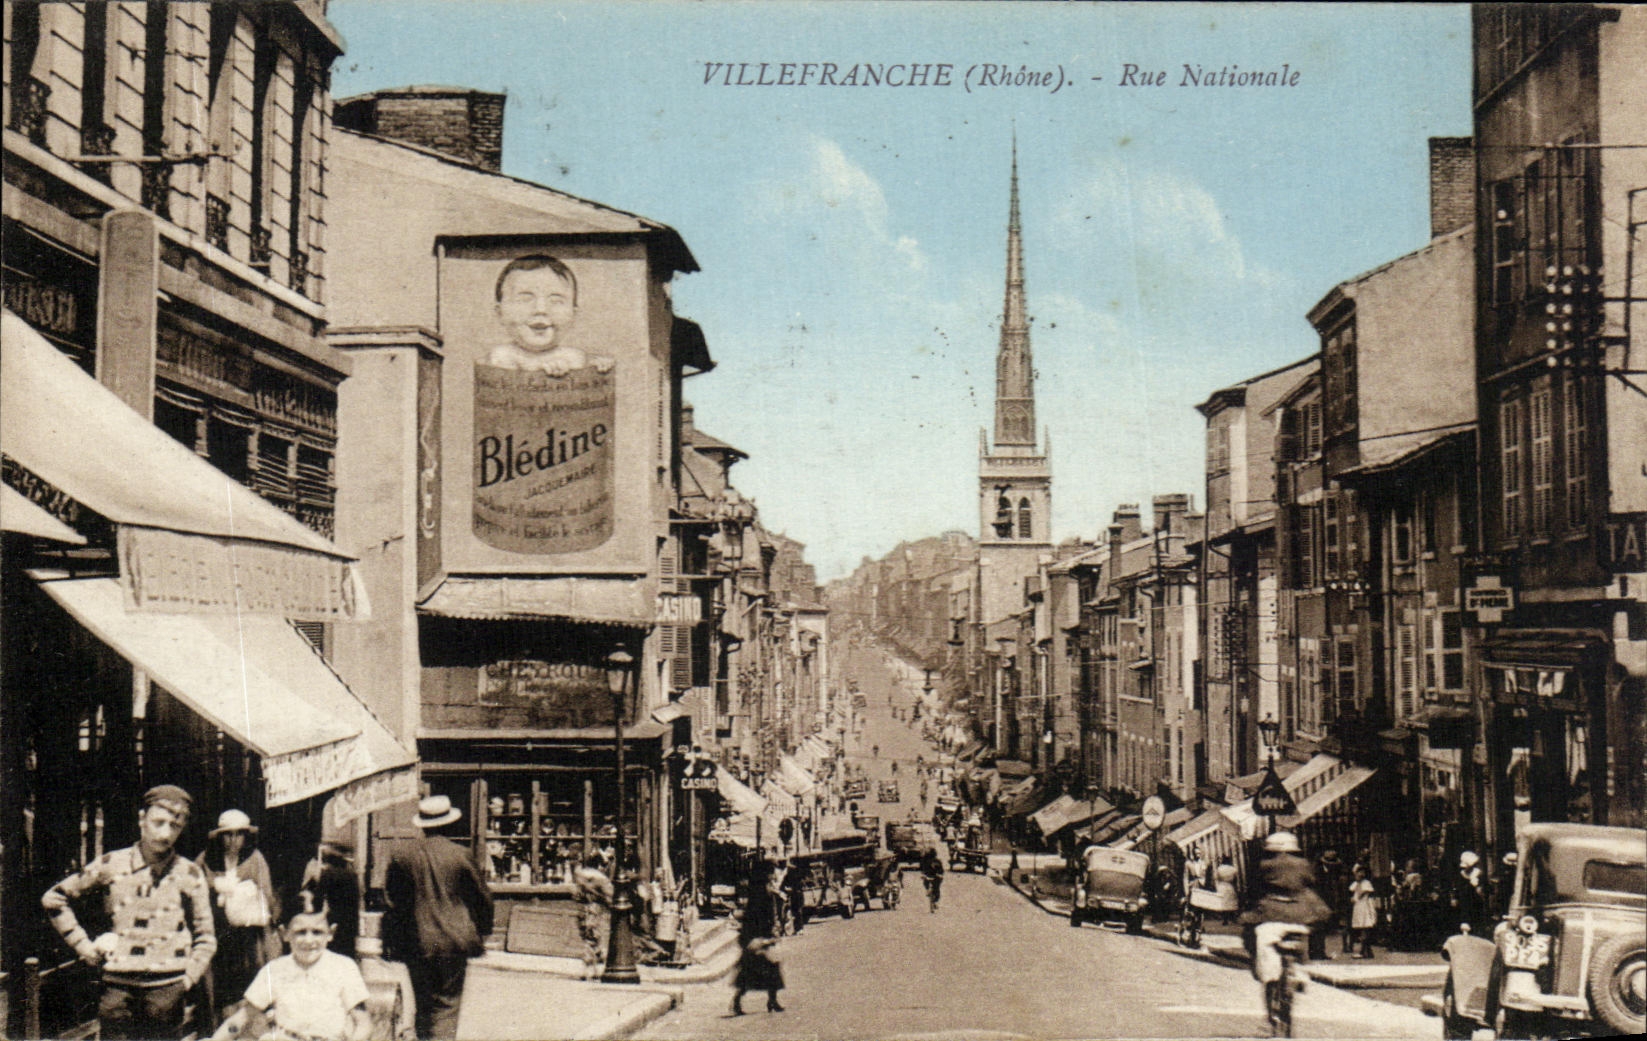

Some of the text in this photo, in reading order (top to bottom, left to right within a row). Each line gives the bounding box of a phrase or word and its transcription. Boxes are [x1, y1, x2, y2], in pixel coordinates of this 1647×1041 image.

[477, 422, 608, 488] Blédine
[523, 463, 598, 500] JACQUEMAIRE
[656, 594, 702, 621] CASINO
[681, 777, 718, 790] CASINO
